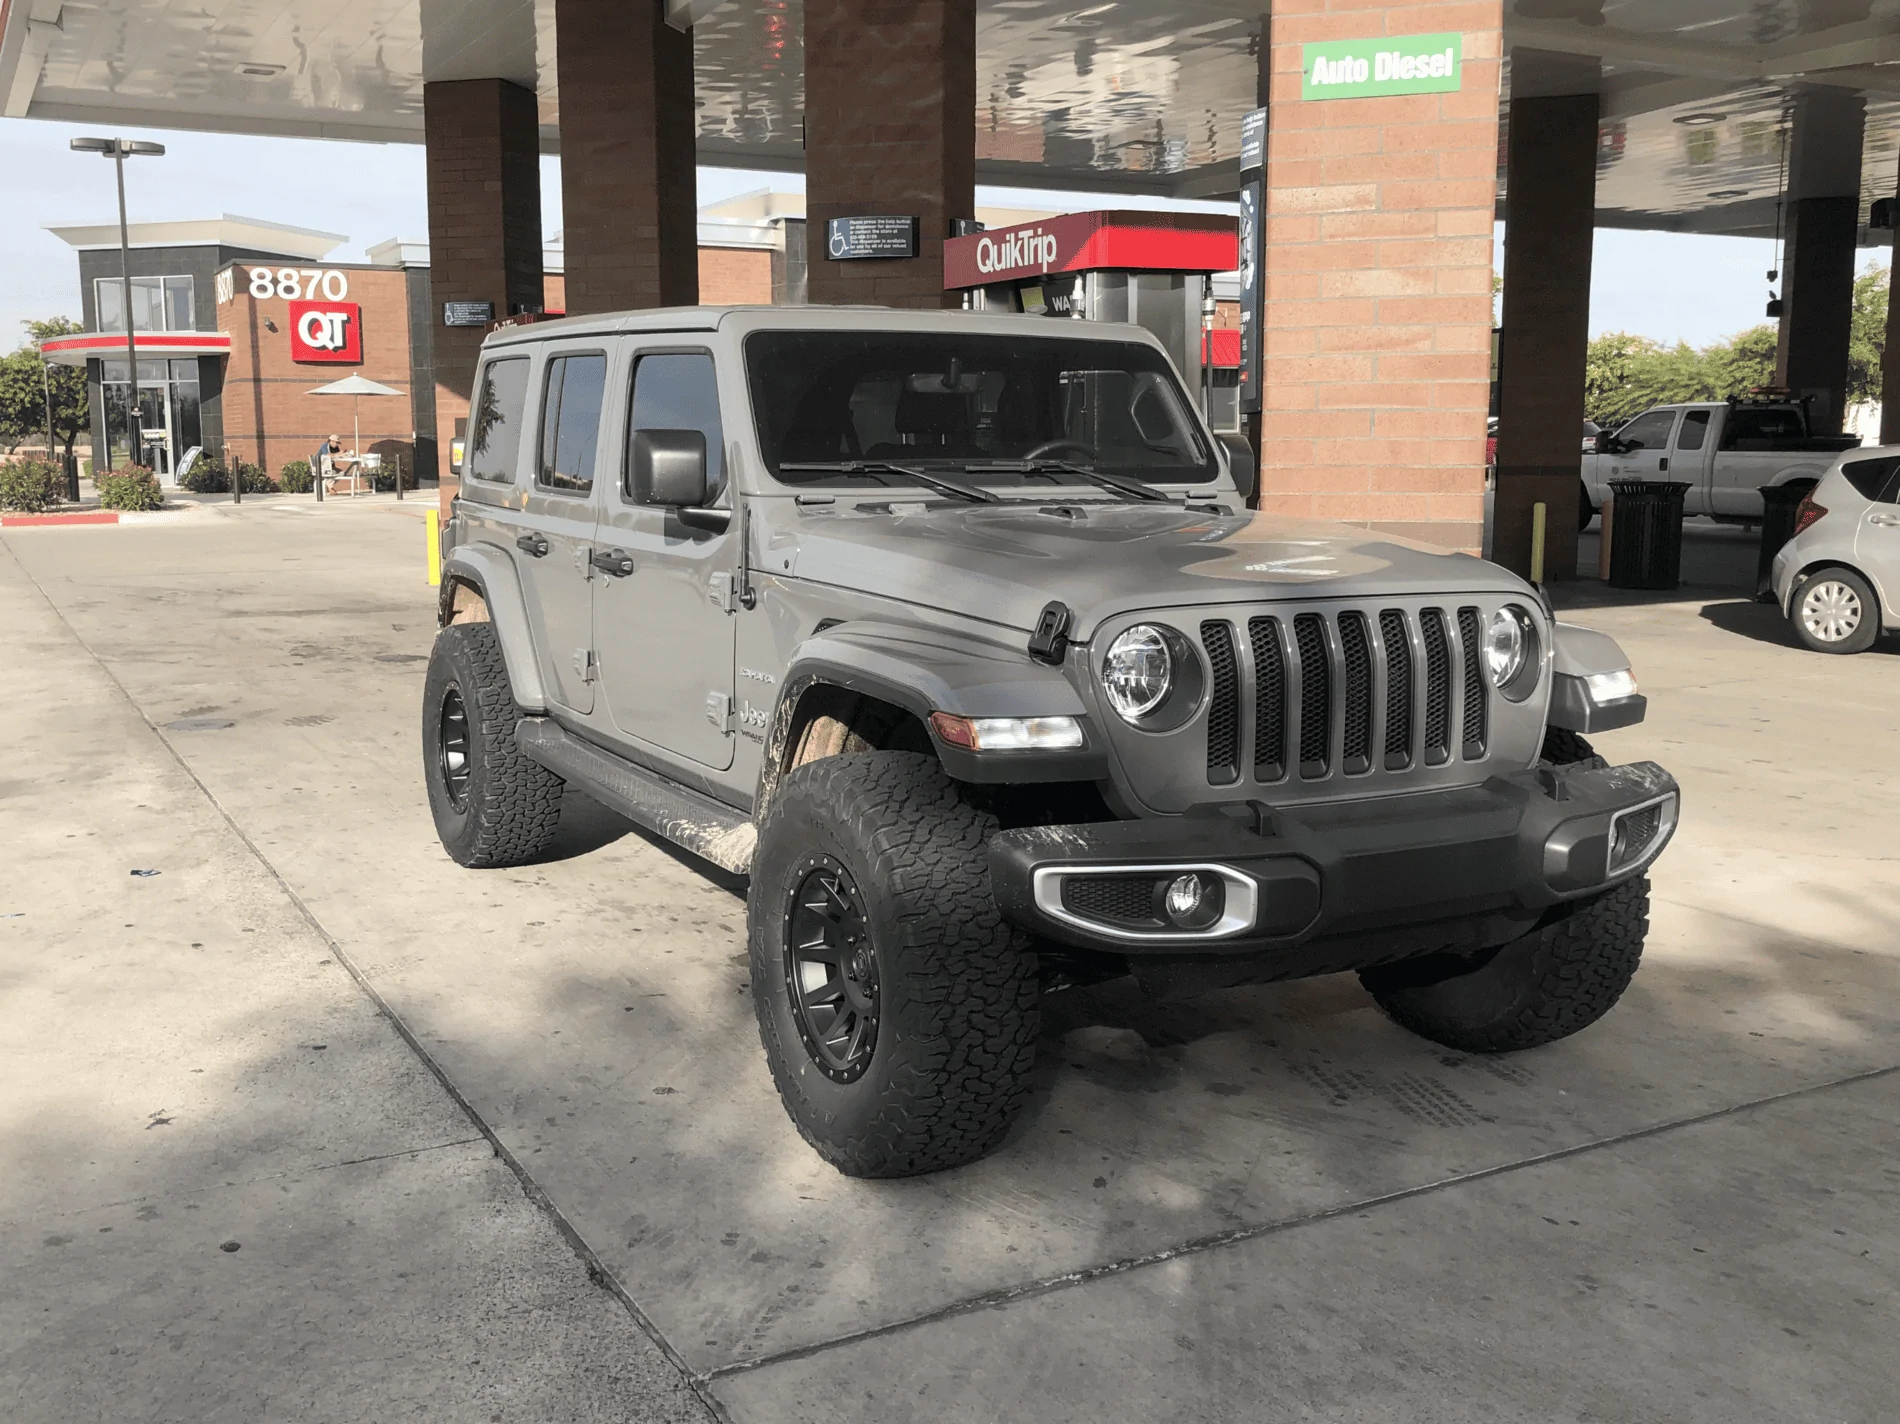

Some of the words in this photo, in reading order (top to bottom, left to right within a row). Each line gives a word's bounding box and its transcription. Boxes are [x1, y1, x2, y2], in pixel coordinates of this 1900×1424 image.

[1311, 55, 1369, 85] Auto
[1375, 47, 1454, 81] Diesel
[977, 228, 1057, 273] QuikTrip
[217, 268, 234, 305] 8870
[250, 267, 348, 301] 8870
[1052, 295, 1073, 312] WA
[298, 311, 348, 350] QT
